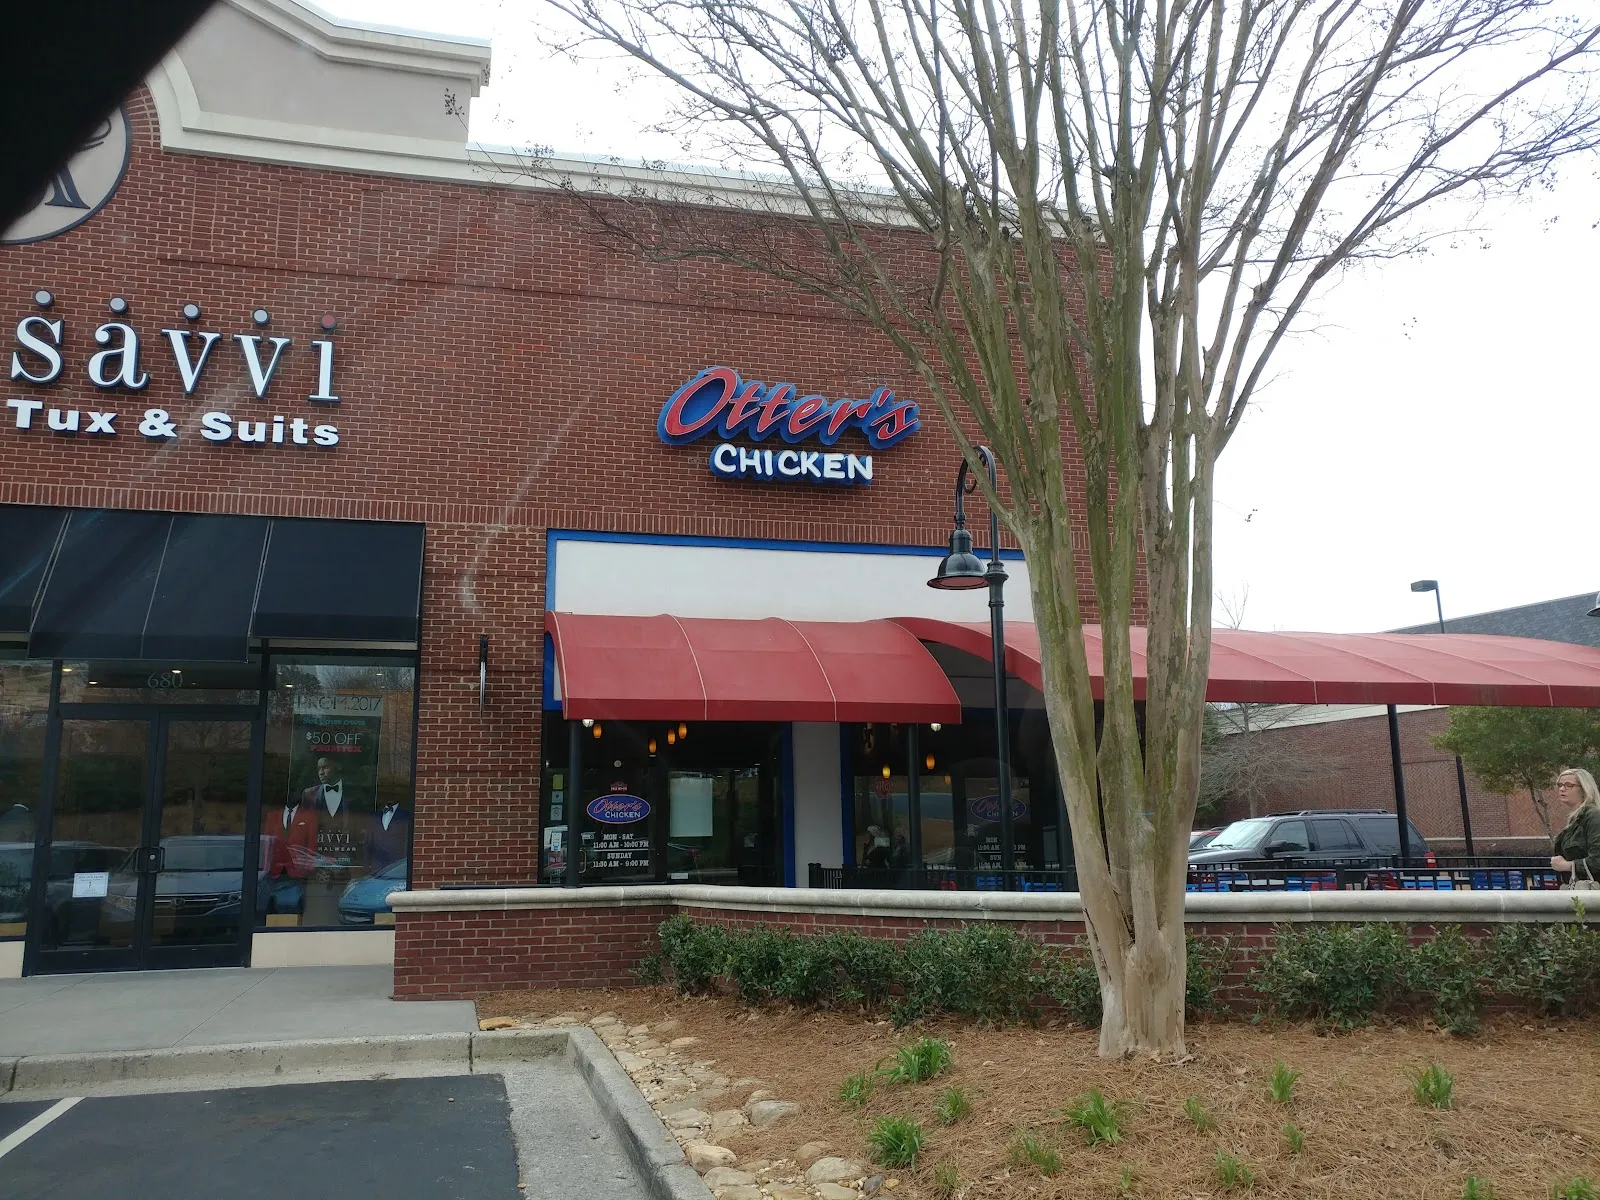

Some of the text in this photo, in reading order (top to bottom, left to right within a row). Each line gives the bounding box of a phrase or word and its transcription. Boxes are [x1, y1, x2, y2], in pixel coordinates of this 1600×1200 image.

[9, 289, 340, 402] savvi
[661, 366, 920, 444] Otter's
[6, 399, 340, 447] Tux & Suits
[711, 443, 873, 482] CHICKEN
[147, 672, 183, 688] 680
[350, 696, 383, 711] 2017
[306, 732, 361, 745] $50 OFF
[603, 833, 617, 841] MON
